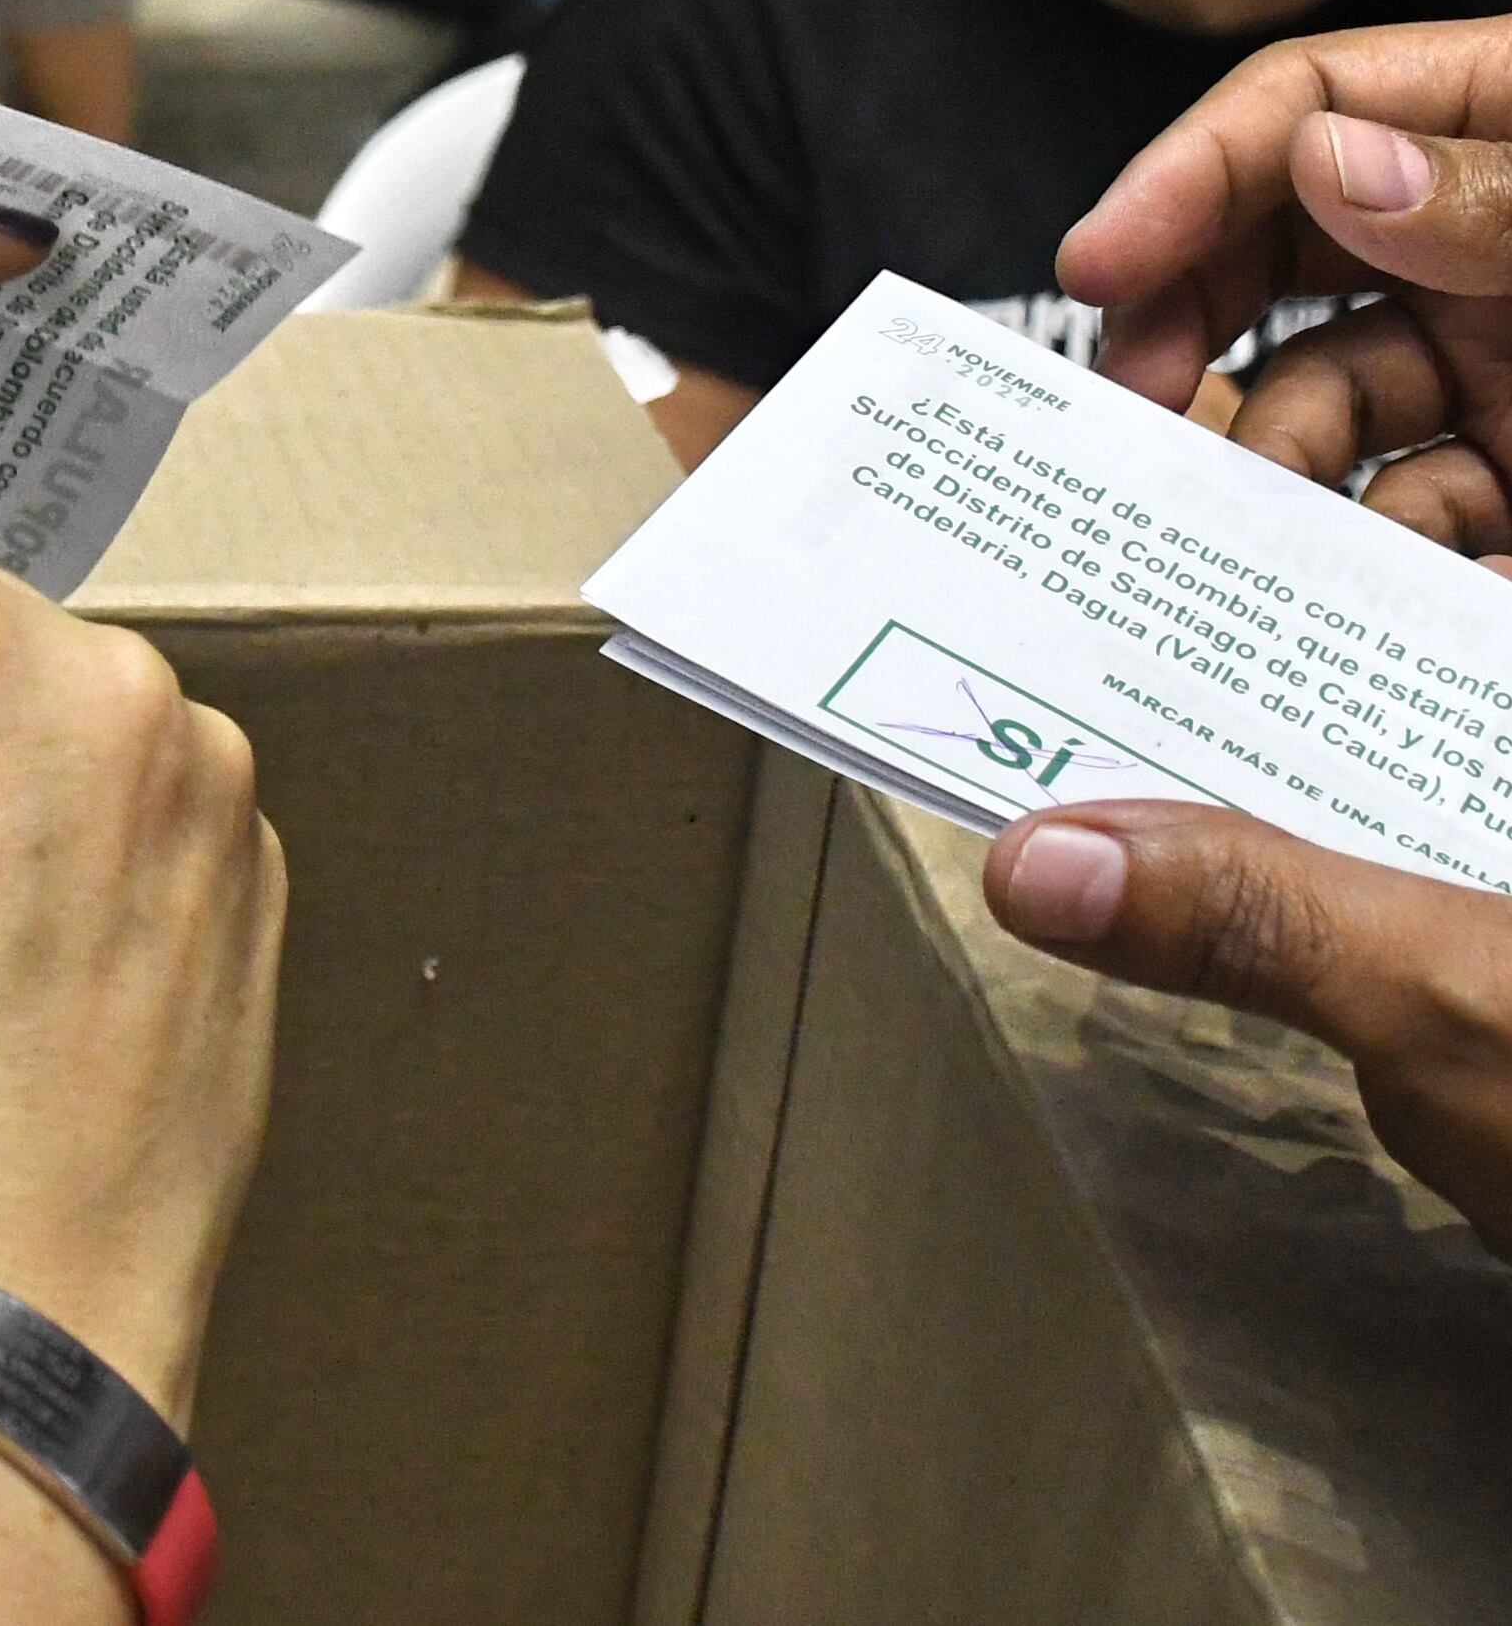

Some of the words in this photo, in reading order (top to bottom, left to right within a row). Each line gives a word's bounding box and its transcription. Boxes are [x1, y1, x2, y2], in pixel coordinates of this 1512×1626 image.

[10, 348, 83, 463] acuerdo
[878, 318, 945, 356] 24
[947, 344, 1072, 412] NOVIEMBRE
[851, 396, 1062, 519] Suroccidente
[1071, 518, 1111, 545] de
[1121, 541, 1282, 641] Colombia,
[1297, 636, 1359, 675] que
[1369, 673, 1485, 739] estaría
[852, 466, 1027, 579] Candelaria,
[1041, 570, 1147, 640] Dagua
[1156, 634, 1250, 694] (Valle
[1260, 694, 1315, 729] del
[1322, 723, 1445, 805] Cauca),
[886, 452, 925, 479] de
[933, 474, 1052, 549] Distrito
[1061, 549, 1101, 577] de
[1110, 572, 1257, 659] Santiago
[1266, 659, 1307, 687] de
[1319, 683, 1387, 736] Cali,
[1397, 727, 1424, 749] y
[1431, 739, 1484, 778] los
[911, 398, 1006, 453] ¿Está
[1013, 450, 1107, 505] usted
[1112, 502, 1152, 529] de
[1160, 527, 1294, 603] acuerdo
[1305, 602, 1366, 641] con
[1375, 632, 1406, 661] la
[976, 718, 1087, 787] SÍ
[1102, 674, 1215, 743] MARCAR
[1221, 739, 1279, 777] MÁS
[1286, 774, 1323, 801] DE
[1330, 798, 1385, 837] UNA
[1396, 834, 1512, 905] CASILLA
